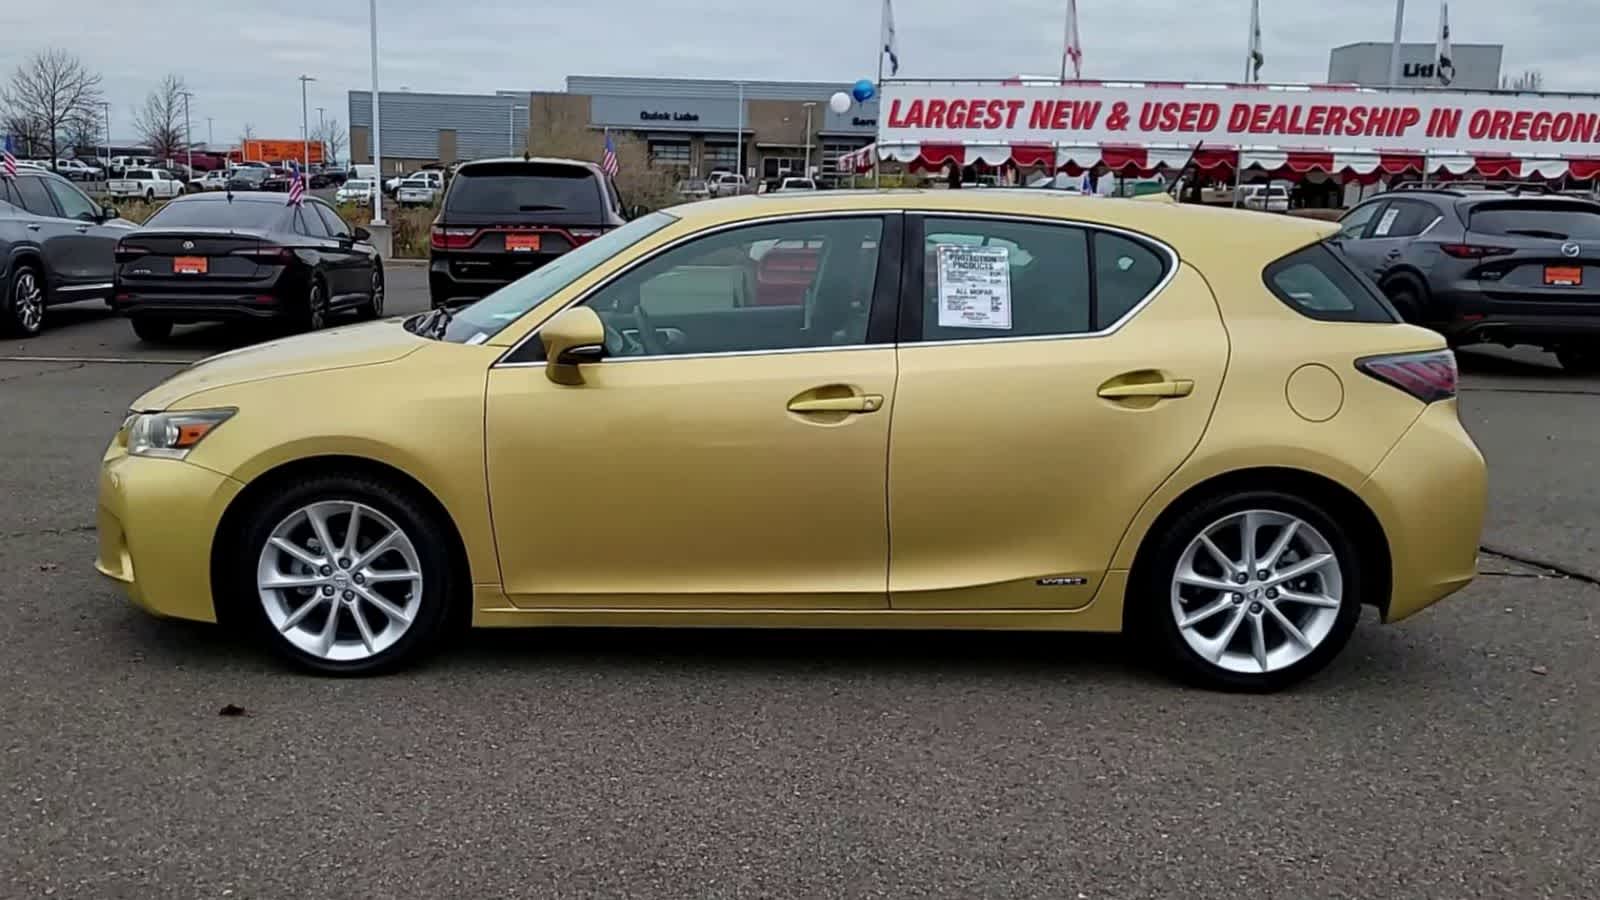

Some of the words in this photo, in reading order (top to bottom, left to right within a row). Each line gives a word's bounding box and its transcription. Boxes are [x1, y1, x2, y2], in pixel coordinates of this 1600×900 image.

[887, 99, 1024, 129] LARGEST
[1027, 101, 1101, 129] NEW
[1105, 103, 1130, 130] &
[1136, 104, 1223, 132] USED
[1227, 104, 1420, 137] DEALERSHIP
[1424, 109, 1461, 137] IN
